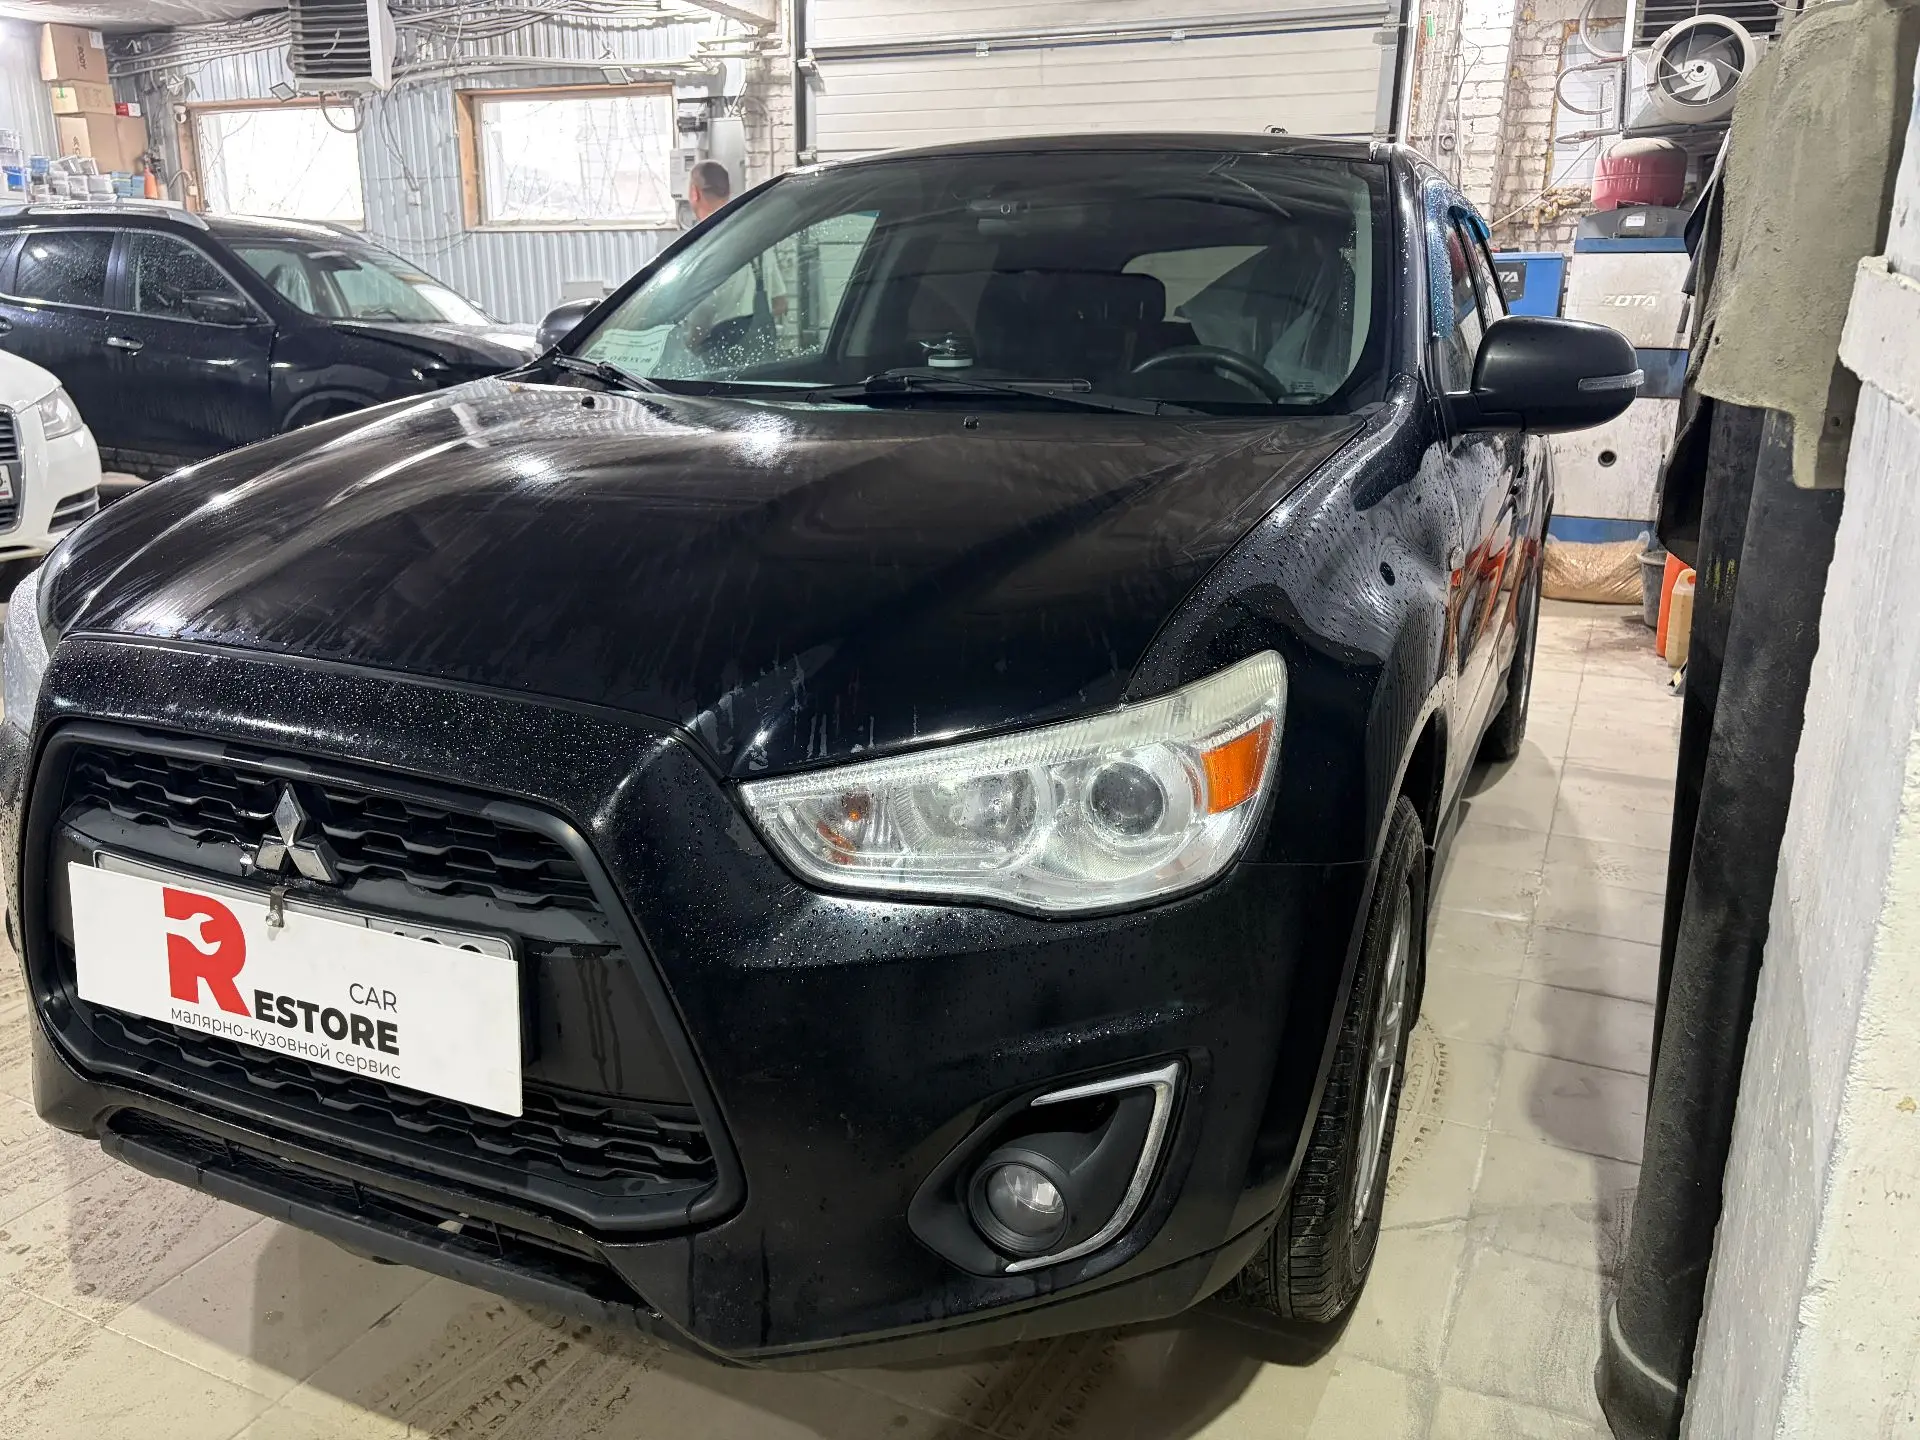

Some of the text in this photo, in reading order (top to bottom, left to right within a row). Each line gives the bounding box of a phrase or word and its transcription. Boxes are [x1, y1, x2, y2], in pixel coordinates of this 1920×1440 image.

[1497, 271, 1519, 283] TA
[1601, 294, 1657, 308] ZOTA
[349, 983, 398, 1013] CAR
[171, 1007, 401, 1079] малярно-кузовной сервис
